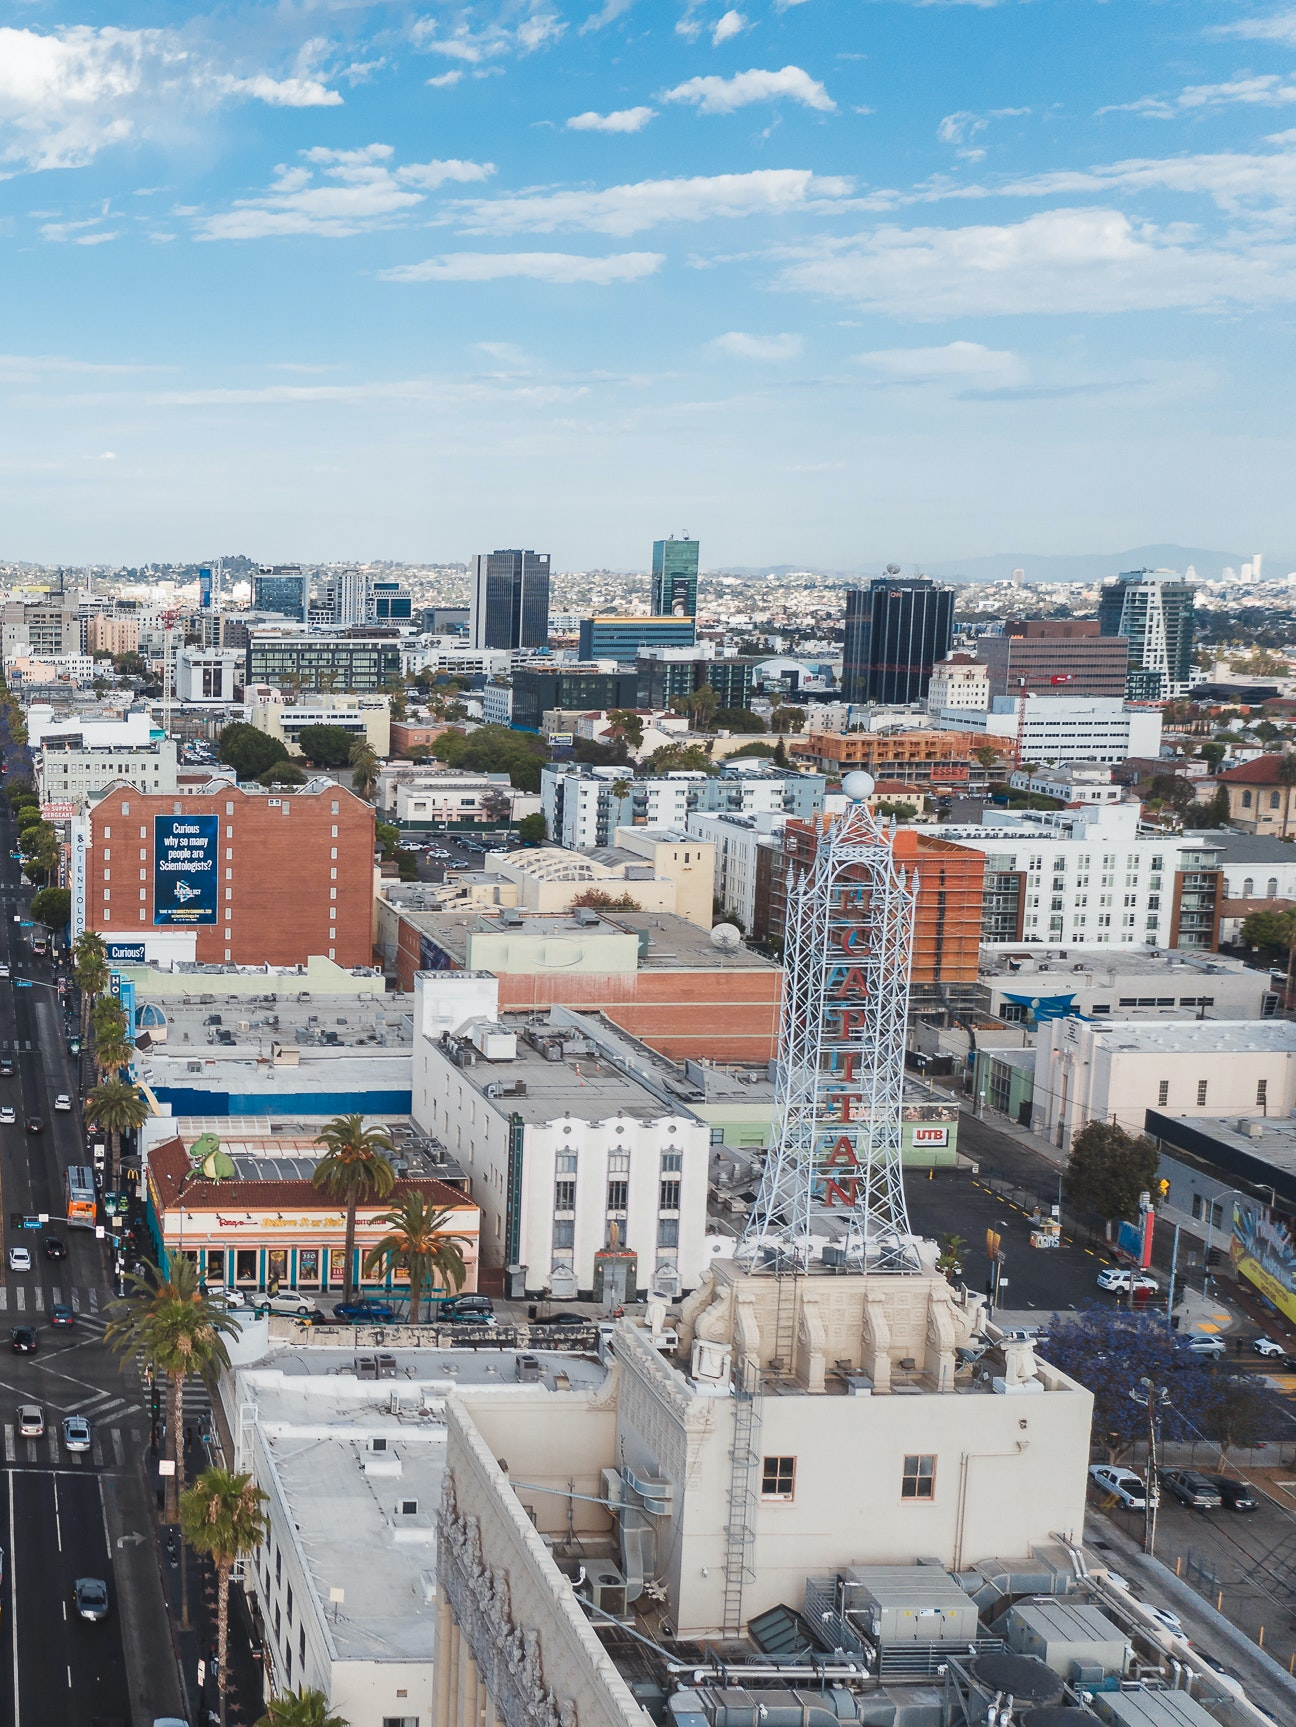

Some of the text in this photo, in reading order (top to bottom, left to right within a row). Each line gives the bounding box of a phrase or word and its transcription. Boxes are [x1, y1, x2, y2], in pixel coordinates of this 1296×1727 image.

[173, 822, 200, 834] Curious
[164, 836, 208, 848] why so many
[168, 848, 204, 860] people are
[159, 860, 212, 873] Scientologists?
[112, 946, 144, 958] Curious?
[917, 1129, 943, 1140] UTB
